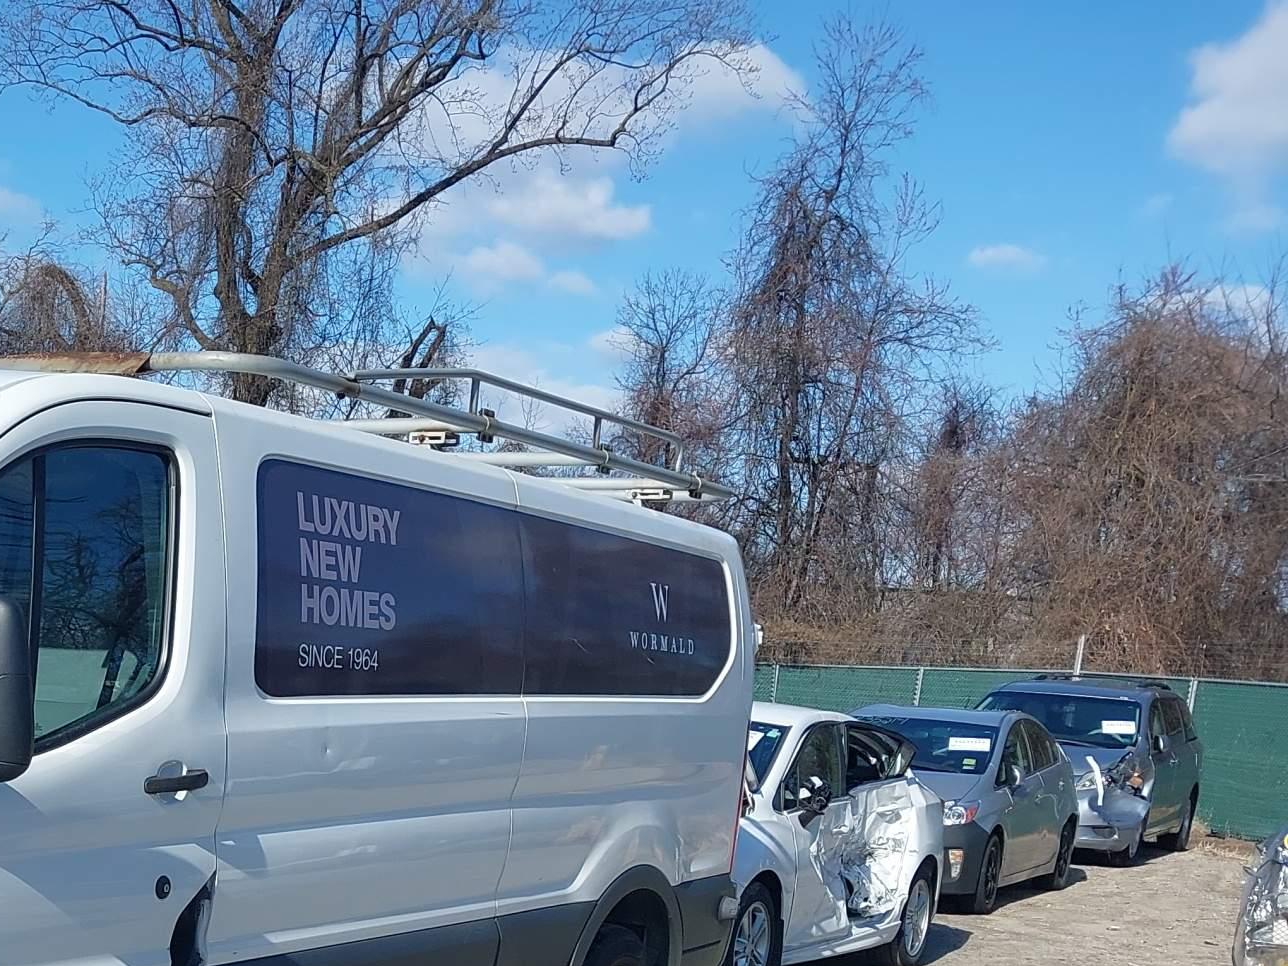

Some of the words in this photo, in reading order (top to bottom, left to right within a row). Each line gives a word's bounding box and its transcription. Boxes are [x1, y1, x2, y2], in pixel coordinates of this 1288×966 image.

[297, 491, 401, 546] LUXURY
[299, 537, 362, 583] NEW
[301, 583, 396, 631] HOMES
[650, 583, 669, 623] W
[298, 643, 343, 669] SINCE
[347, 647, 379, 672] 1964
[629, 631, 695, 655] WORMALD
